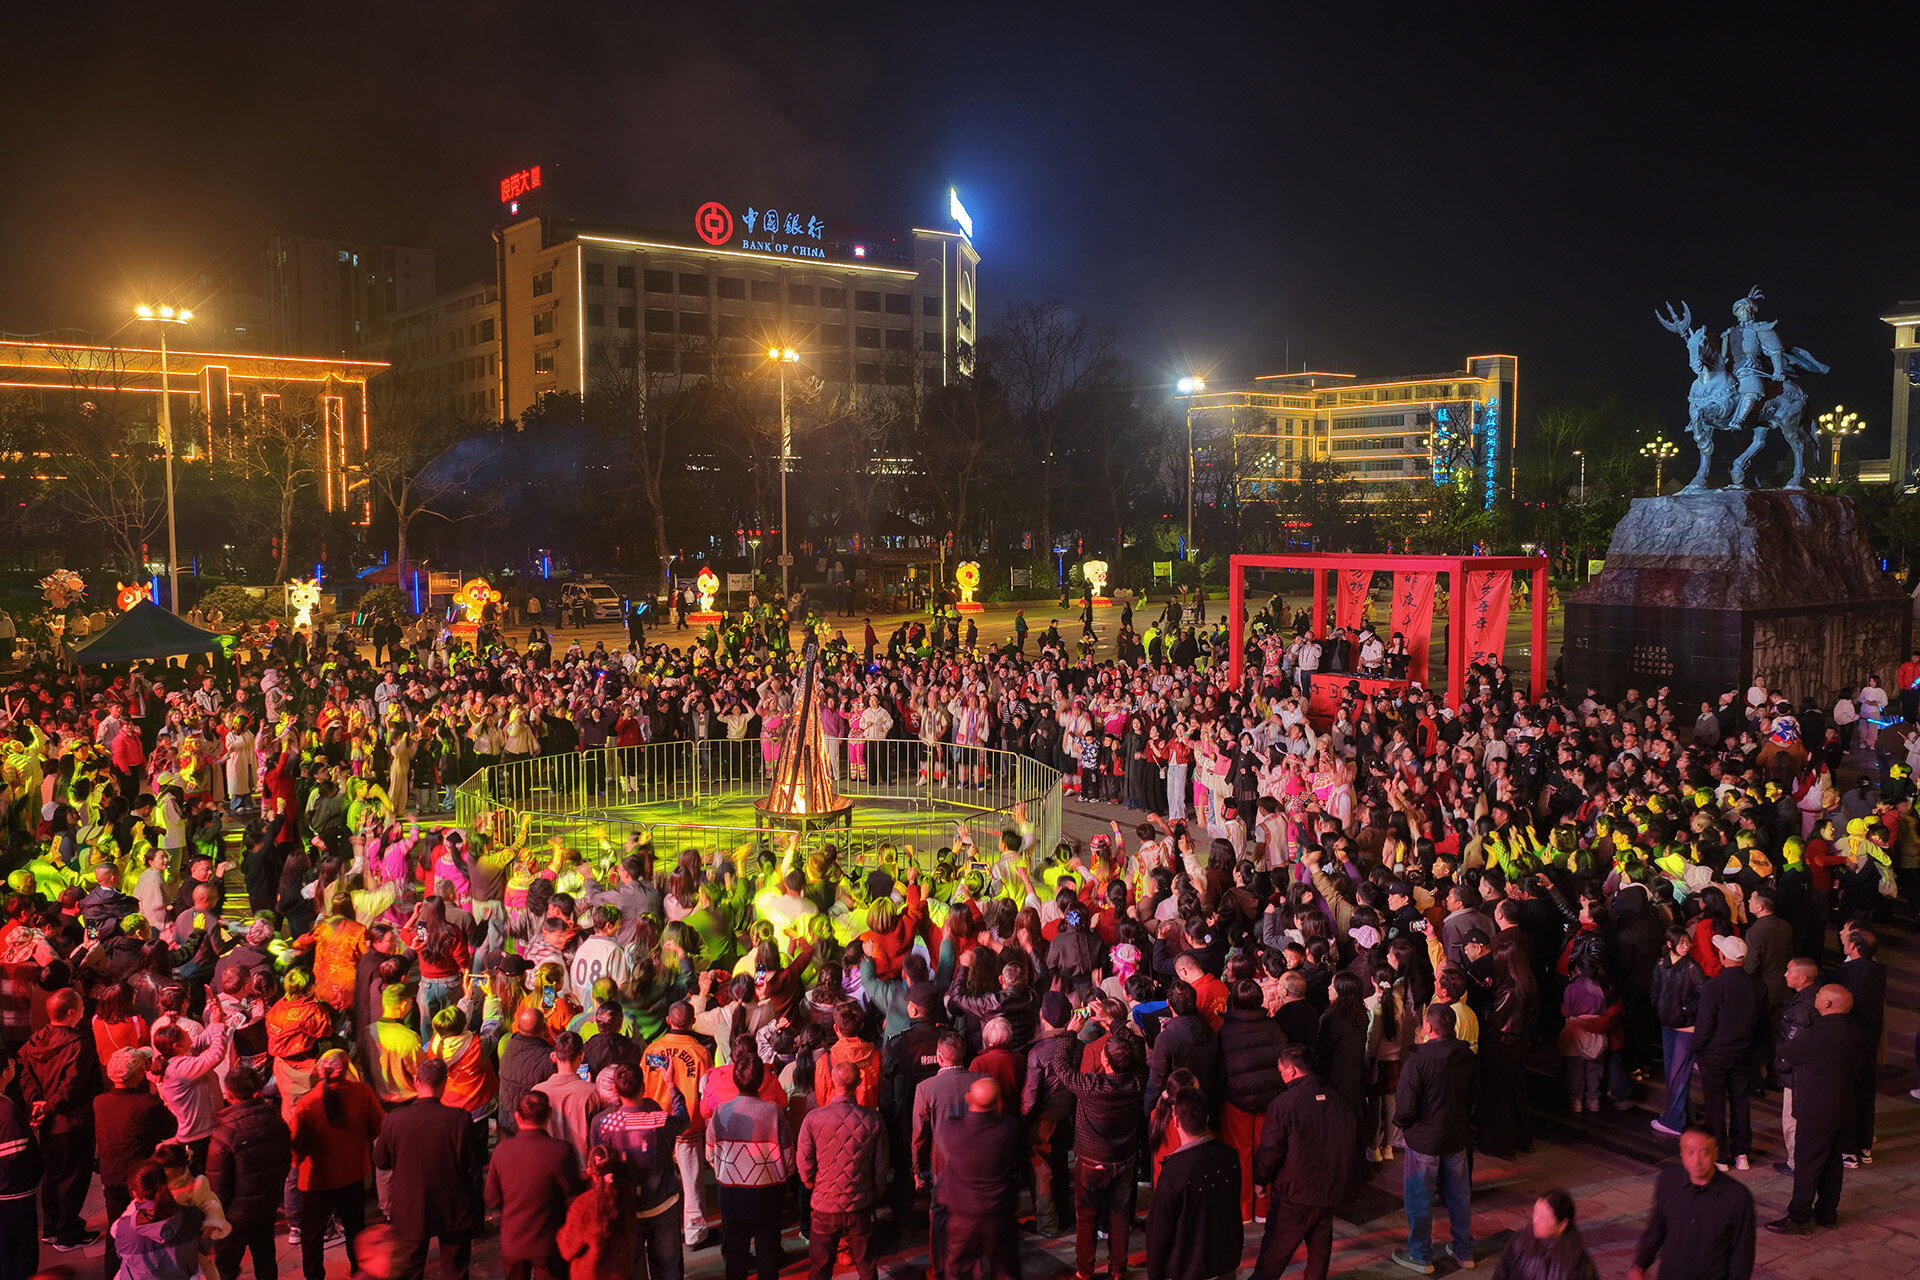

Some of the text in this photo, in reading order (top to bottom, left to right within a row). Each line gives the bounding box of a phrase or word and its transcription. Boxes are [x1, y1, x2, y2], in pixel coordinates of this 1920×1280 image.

[742, 239, 826, 258] BANK OF CHINA
[576, 958, 602, 986] 08
[679, 1049, 696, 1078] HOUSE
